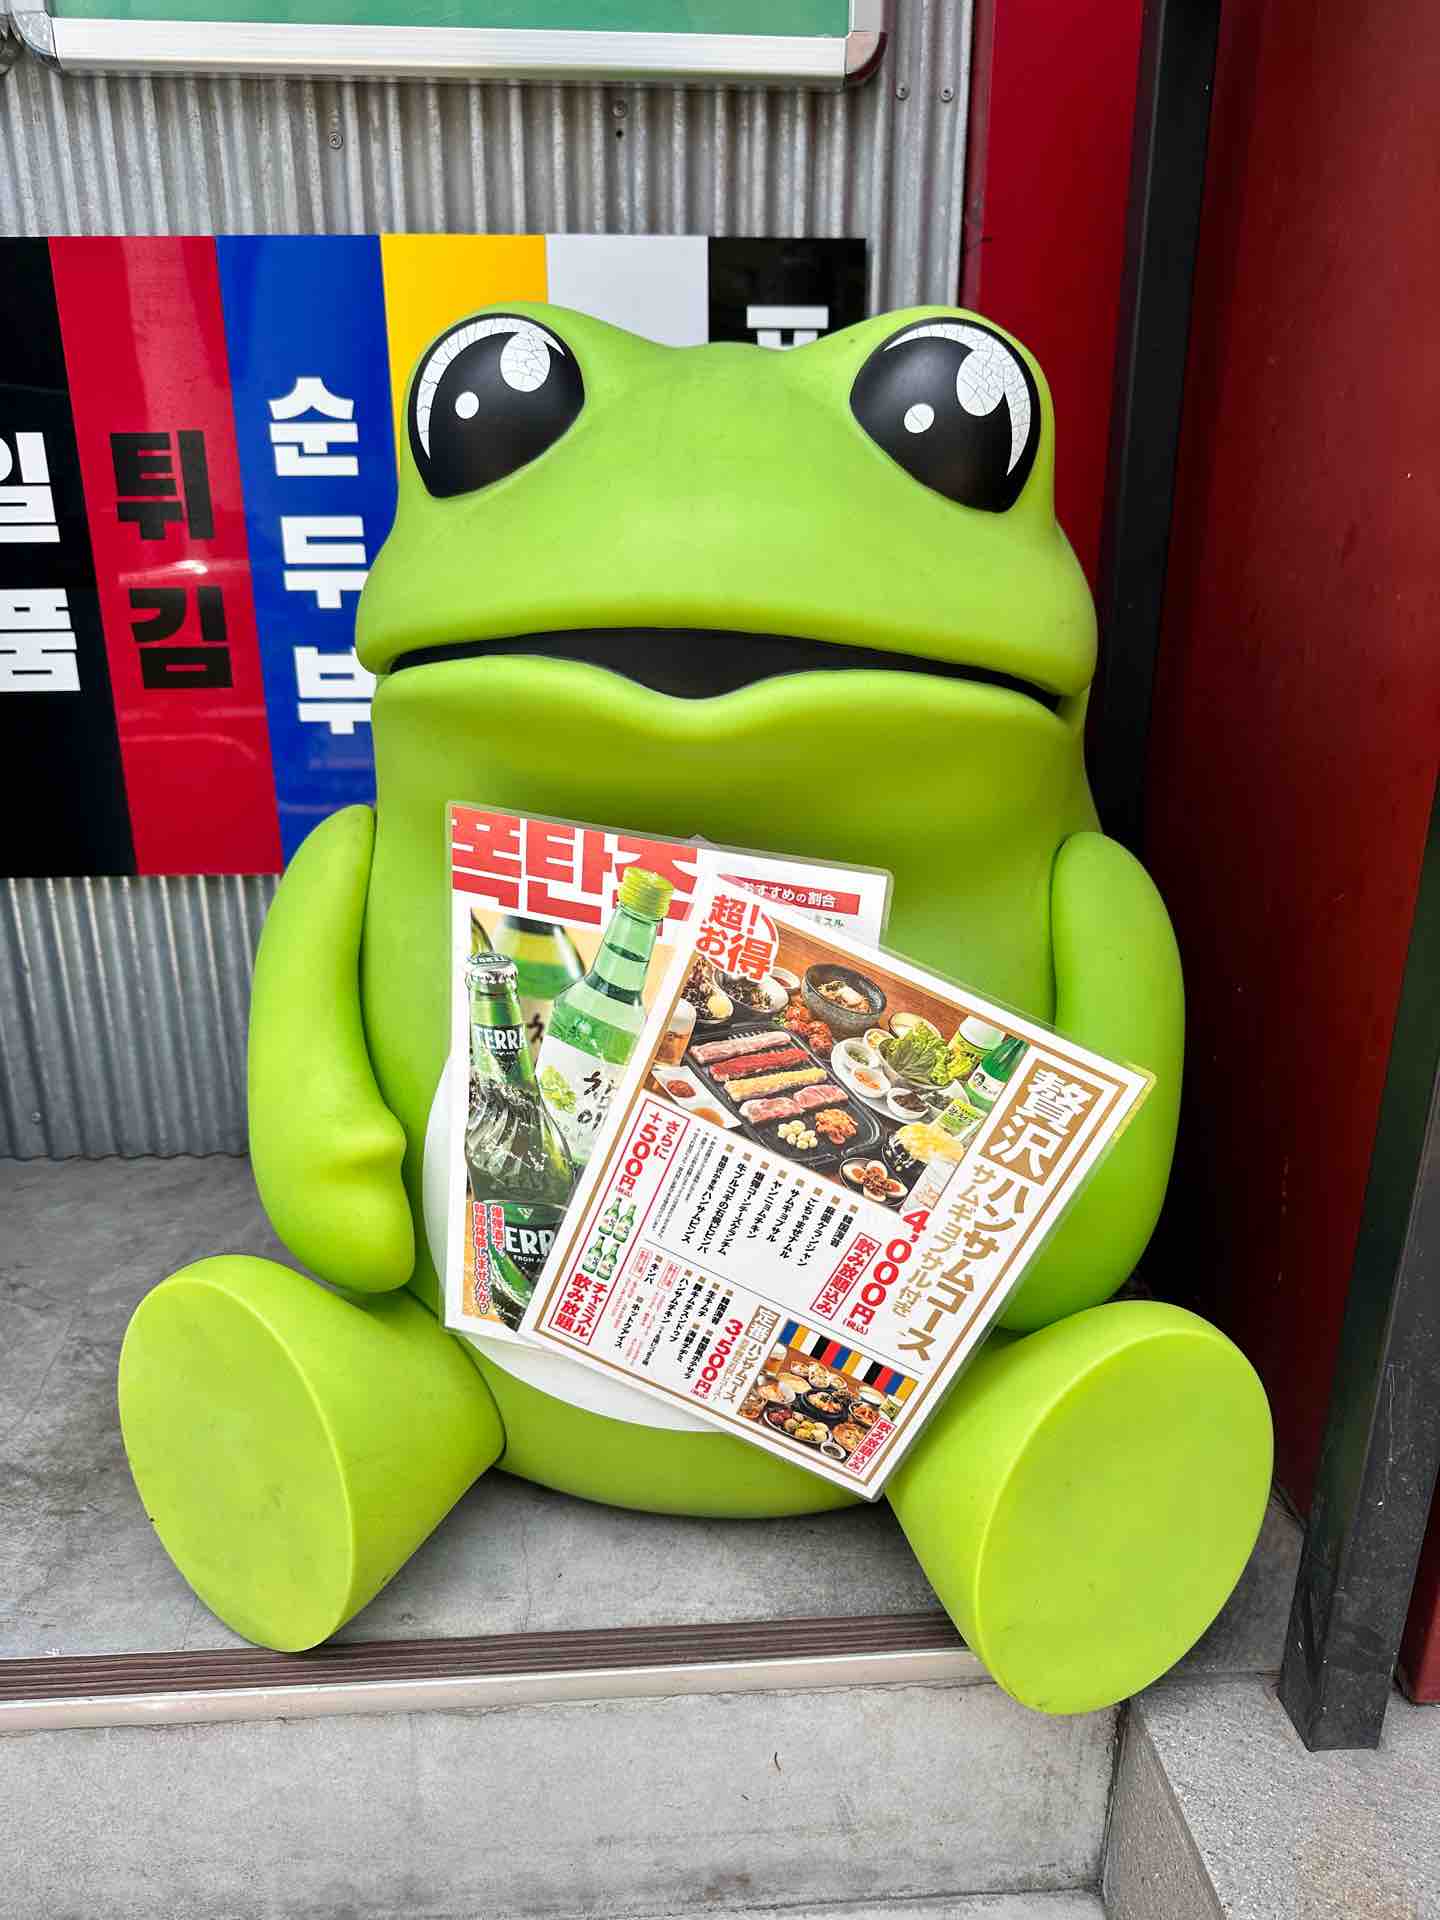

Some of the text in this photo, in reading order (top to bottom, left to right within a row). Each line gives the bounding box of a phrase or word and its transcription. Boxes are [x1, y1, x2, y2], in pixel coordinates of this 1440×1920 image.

[110, 430, 234, 689] 튀김
[268, 377, 377, 735] 순두부
[708, 894, 760, 935] 超!
[695, 924, 773, 981] お得
[651, 1117, 682, 1160] さらに
[504, 1226, 555, 1257] ERR
[745, 1179, 784, 1241] ヤンニョムチキン
[778, 1196, 819, 1259] ごちゃまぜナムル
[887, 1162, 999, 1319] サムギョプサル付き
[894, 1066, 1095, 1363] 贅沢 ハンサムコース
[815, 1236, 877, 1316] 飲み放題込み
[846, 1203, 935, 1325] 4,000円
[553, 1271, 593, 1331] 飲み放題
[571, 1280, 610, 1339] チャミスル
[693, 1317, 745, 1394] 3,500円
